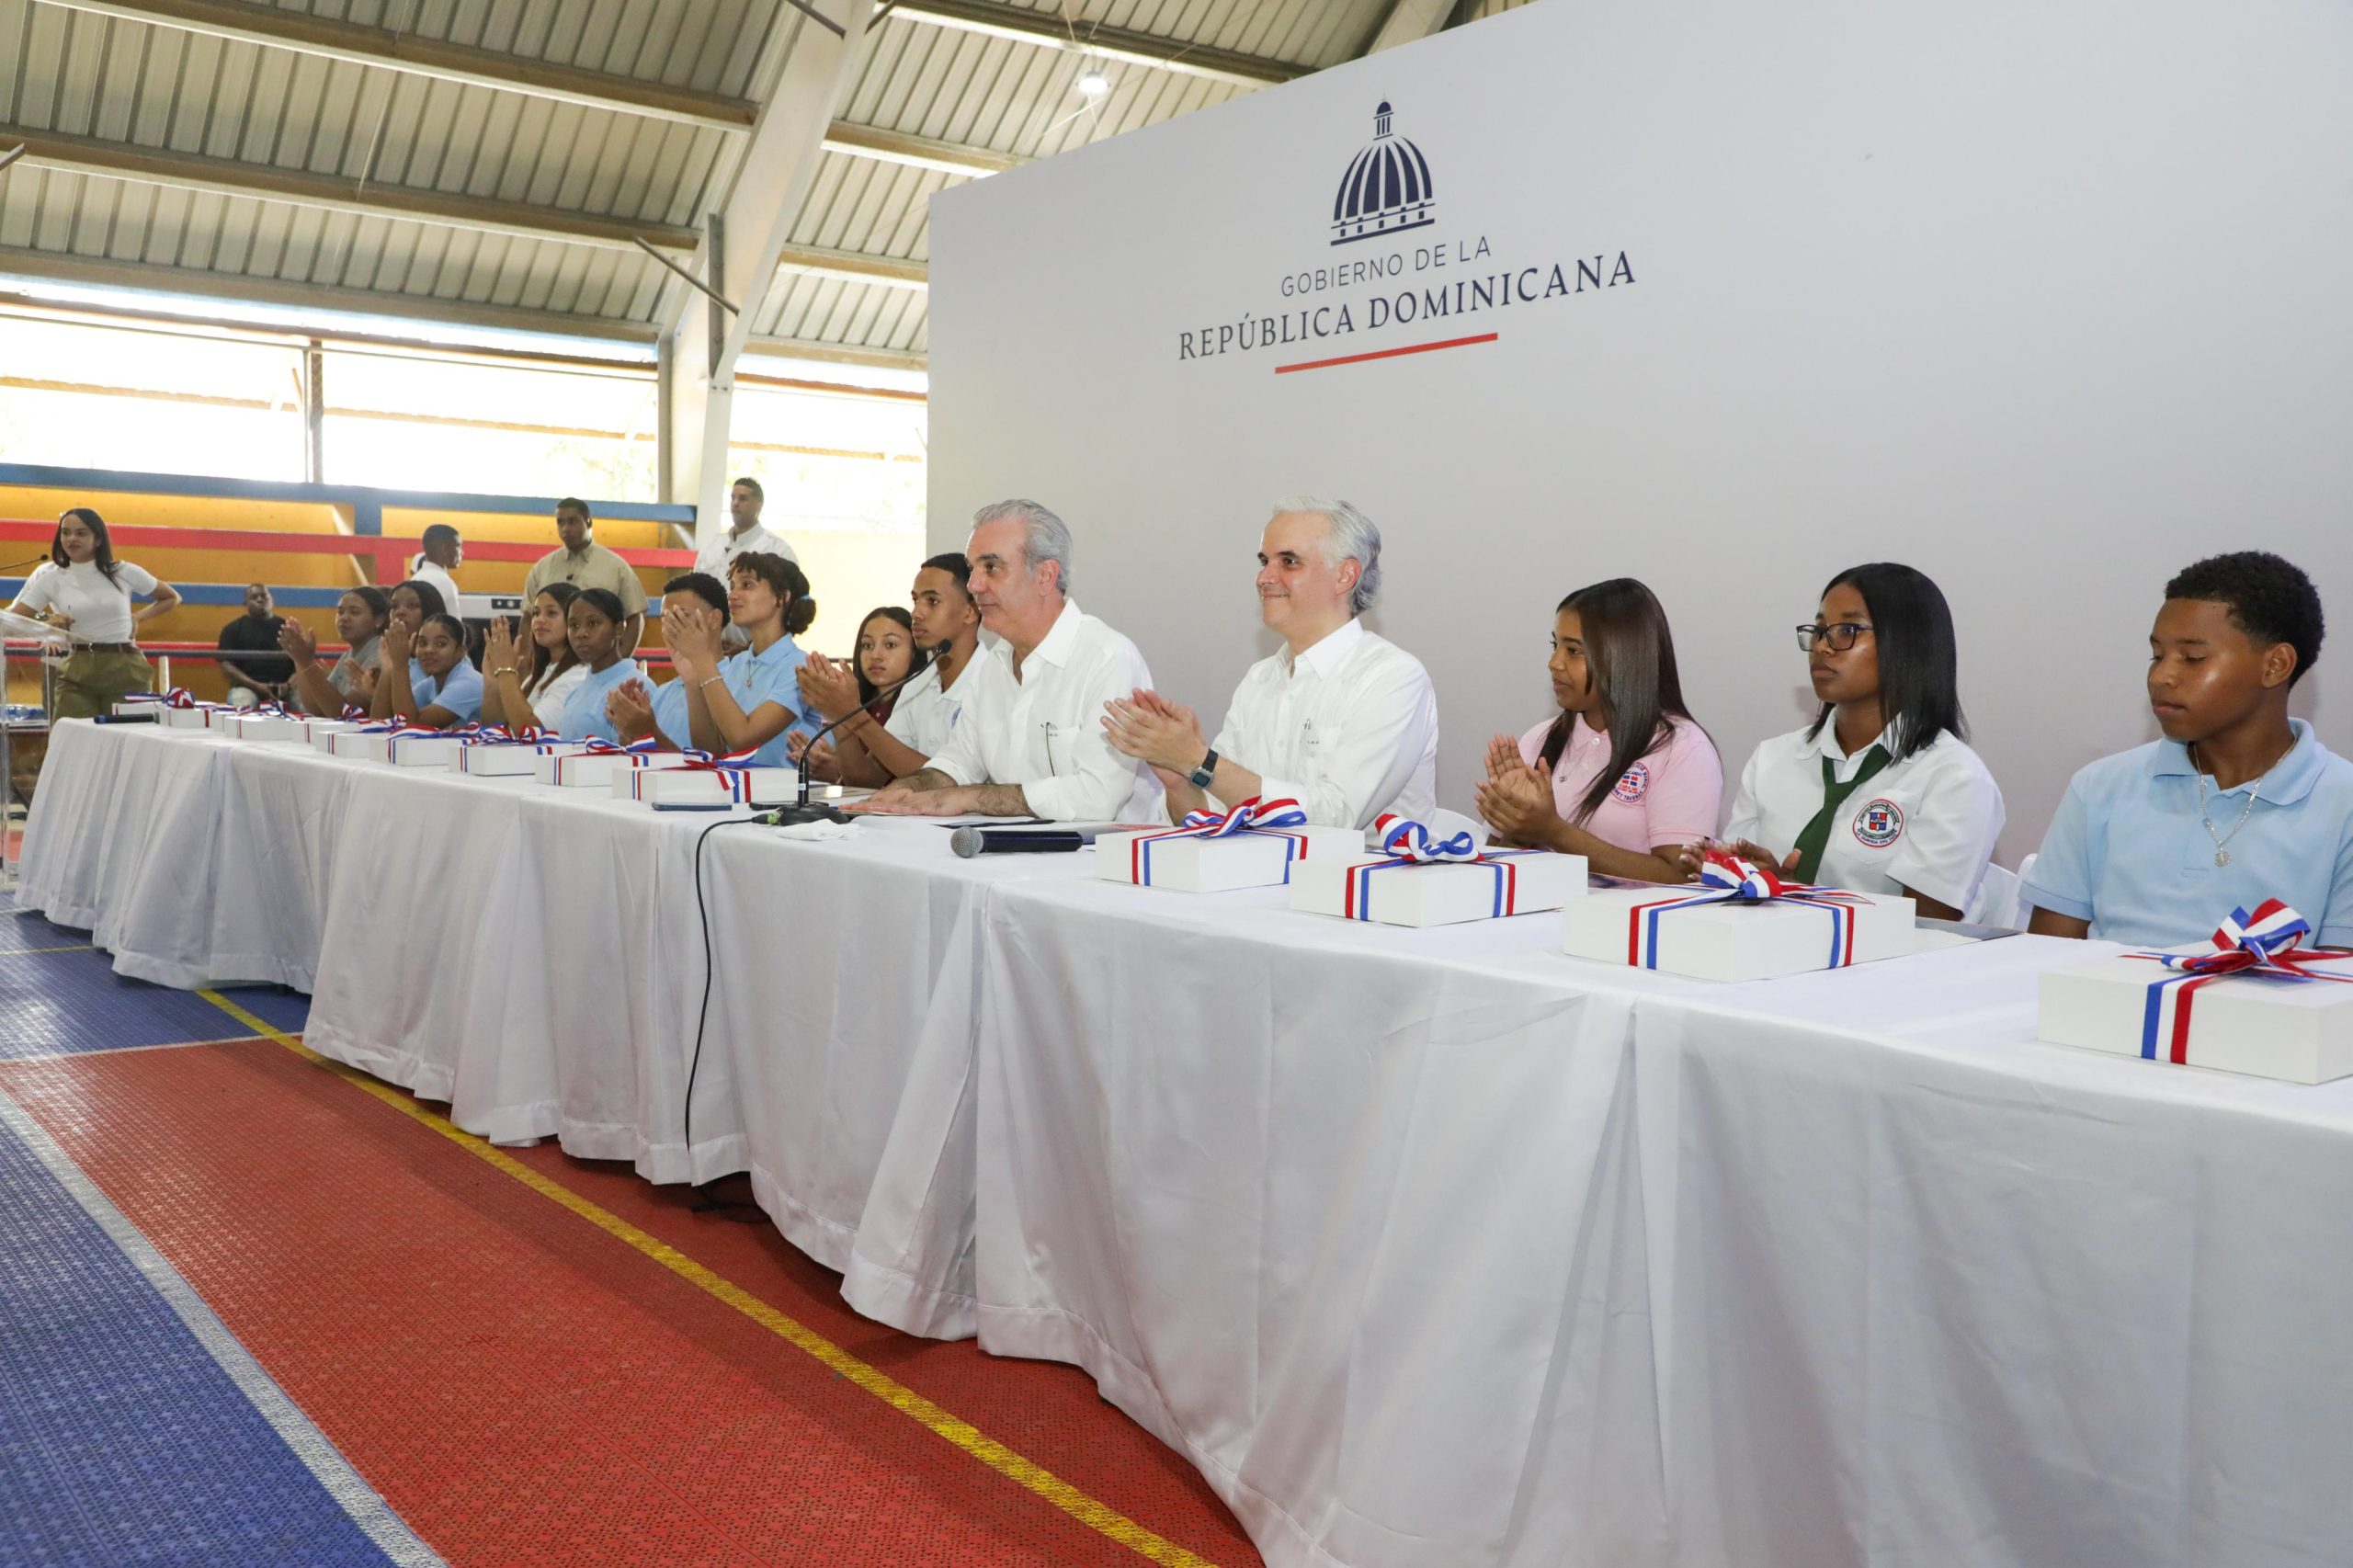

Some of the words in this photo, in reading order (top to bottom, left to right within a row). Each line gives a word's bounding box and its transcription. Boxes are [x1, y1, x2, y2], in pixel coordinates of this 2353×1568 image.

[1178, 303, 1356, 361] REPÚBLICA
[1367, 250, 1636, 329] DOMINICANA
[1280, 253, 1404, 298] GOBIERNO
[1415, 244, 1447, 272] DE
[1459, 235, 1491, 263] LA
